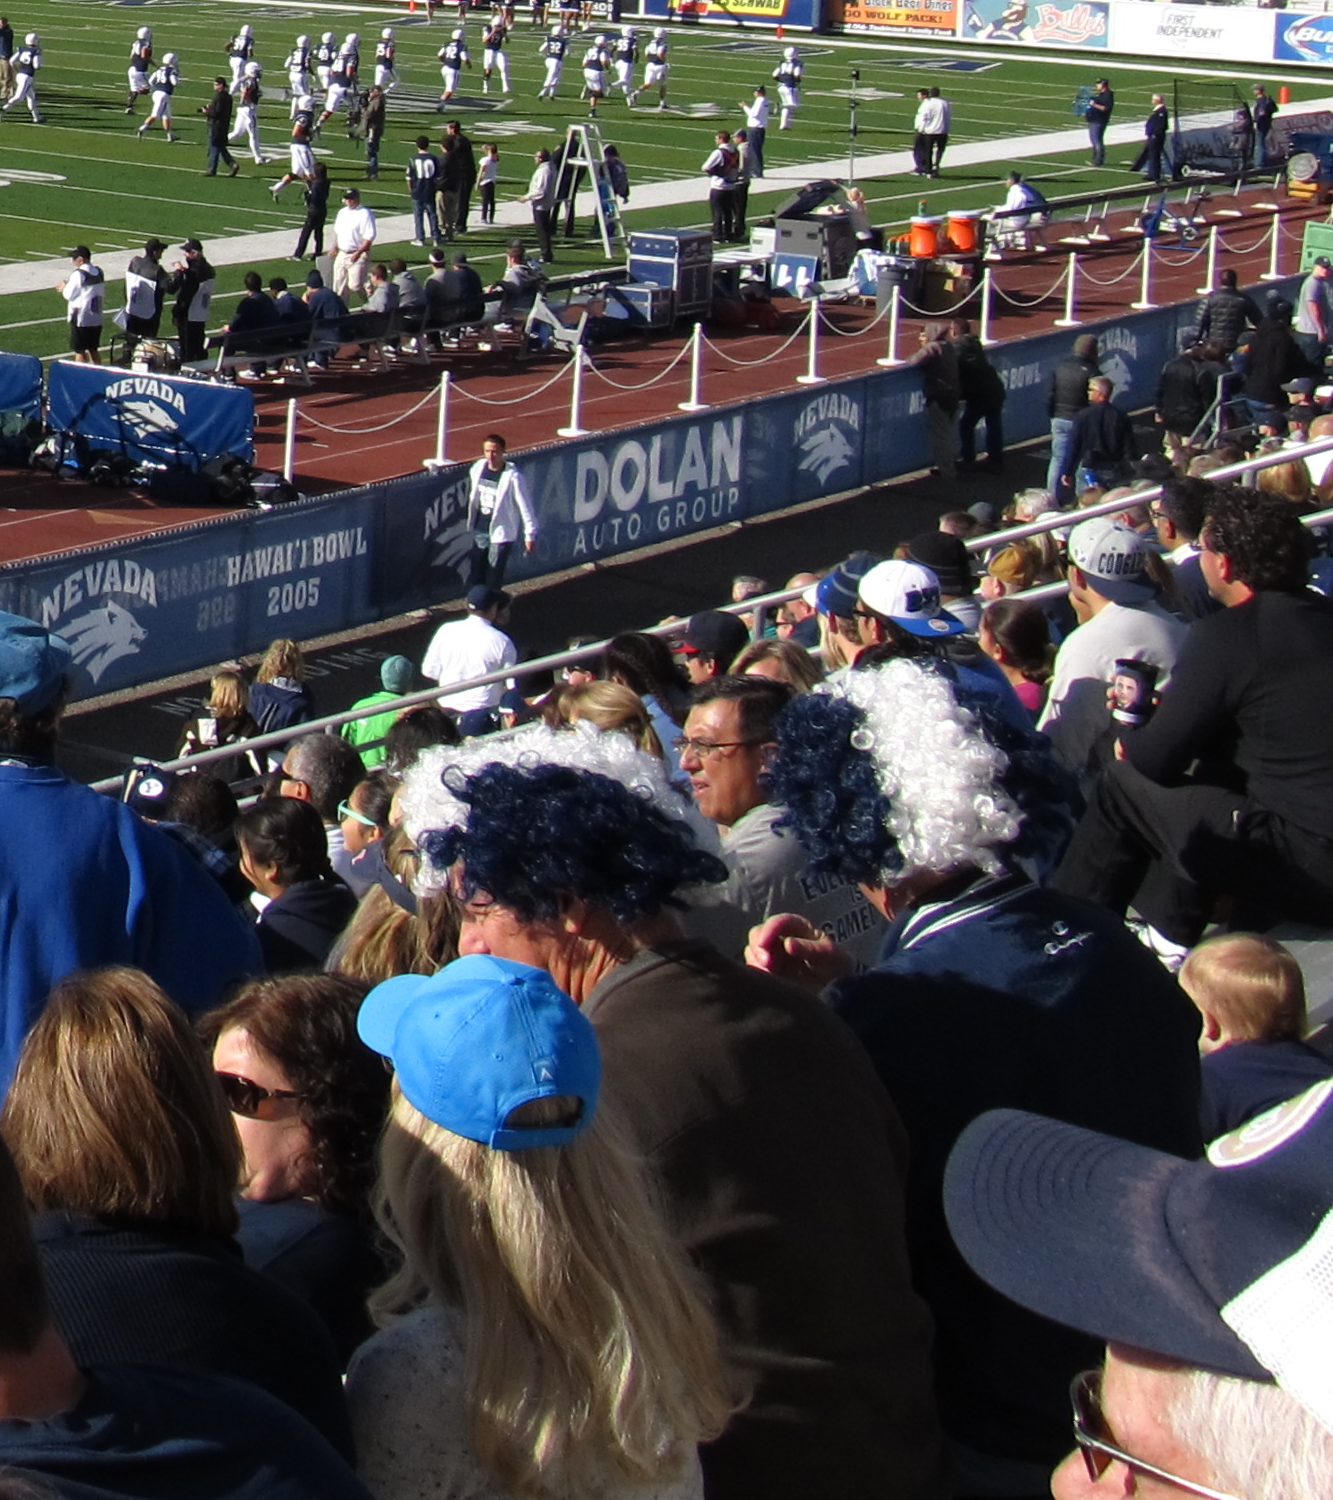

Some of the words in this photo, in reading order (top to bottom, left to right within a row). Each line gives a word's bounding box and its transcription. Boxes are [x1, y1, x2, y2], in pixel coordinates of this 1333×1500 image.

[843, 9, 860, 18] GO
[865, 10, 902, 20] WOLF
[905, 13, 943, 24] PACK!
[1156, 25, 1225, 40] INDEPENDENT
[1166, 14, 1196, 27] FIRST
[1294, 27, 1333, 43] BU
[415, 159, 435, 179] 10
[1009, 362, 1042, 390] BOWL
[104, 378, 186, 416] NEVADA
[794, 393, 860, 442] NEVADA
[574, 415, 744, 523] DOLAN
[573, 512, 642, 556] AUTO
[657, 486, 740, 532] GROUP
[312, 526, 367, 564] BOWL
[41, 560, 158, 624] NEVADA
[266, 577, 322, 617] 2005
[823, 905, 874, 944] GAME
